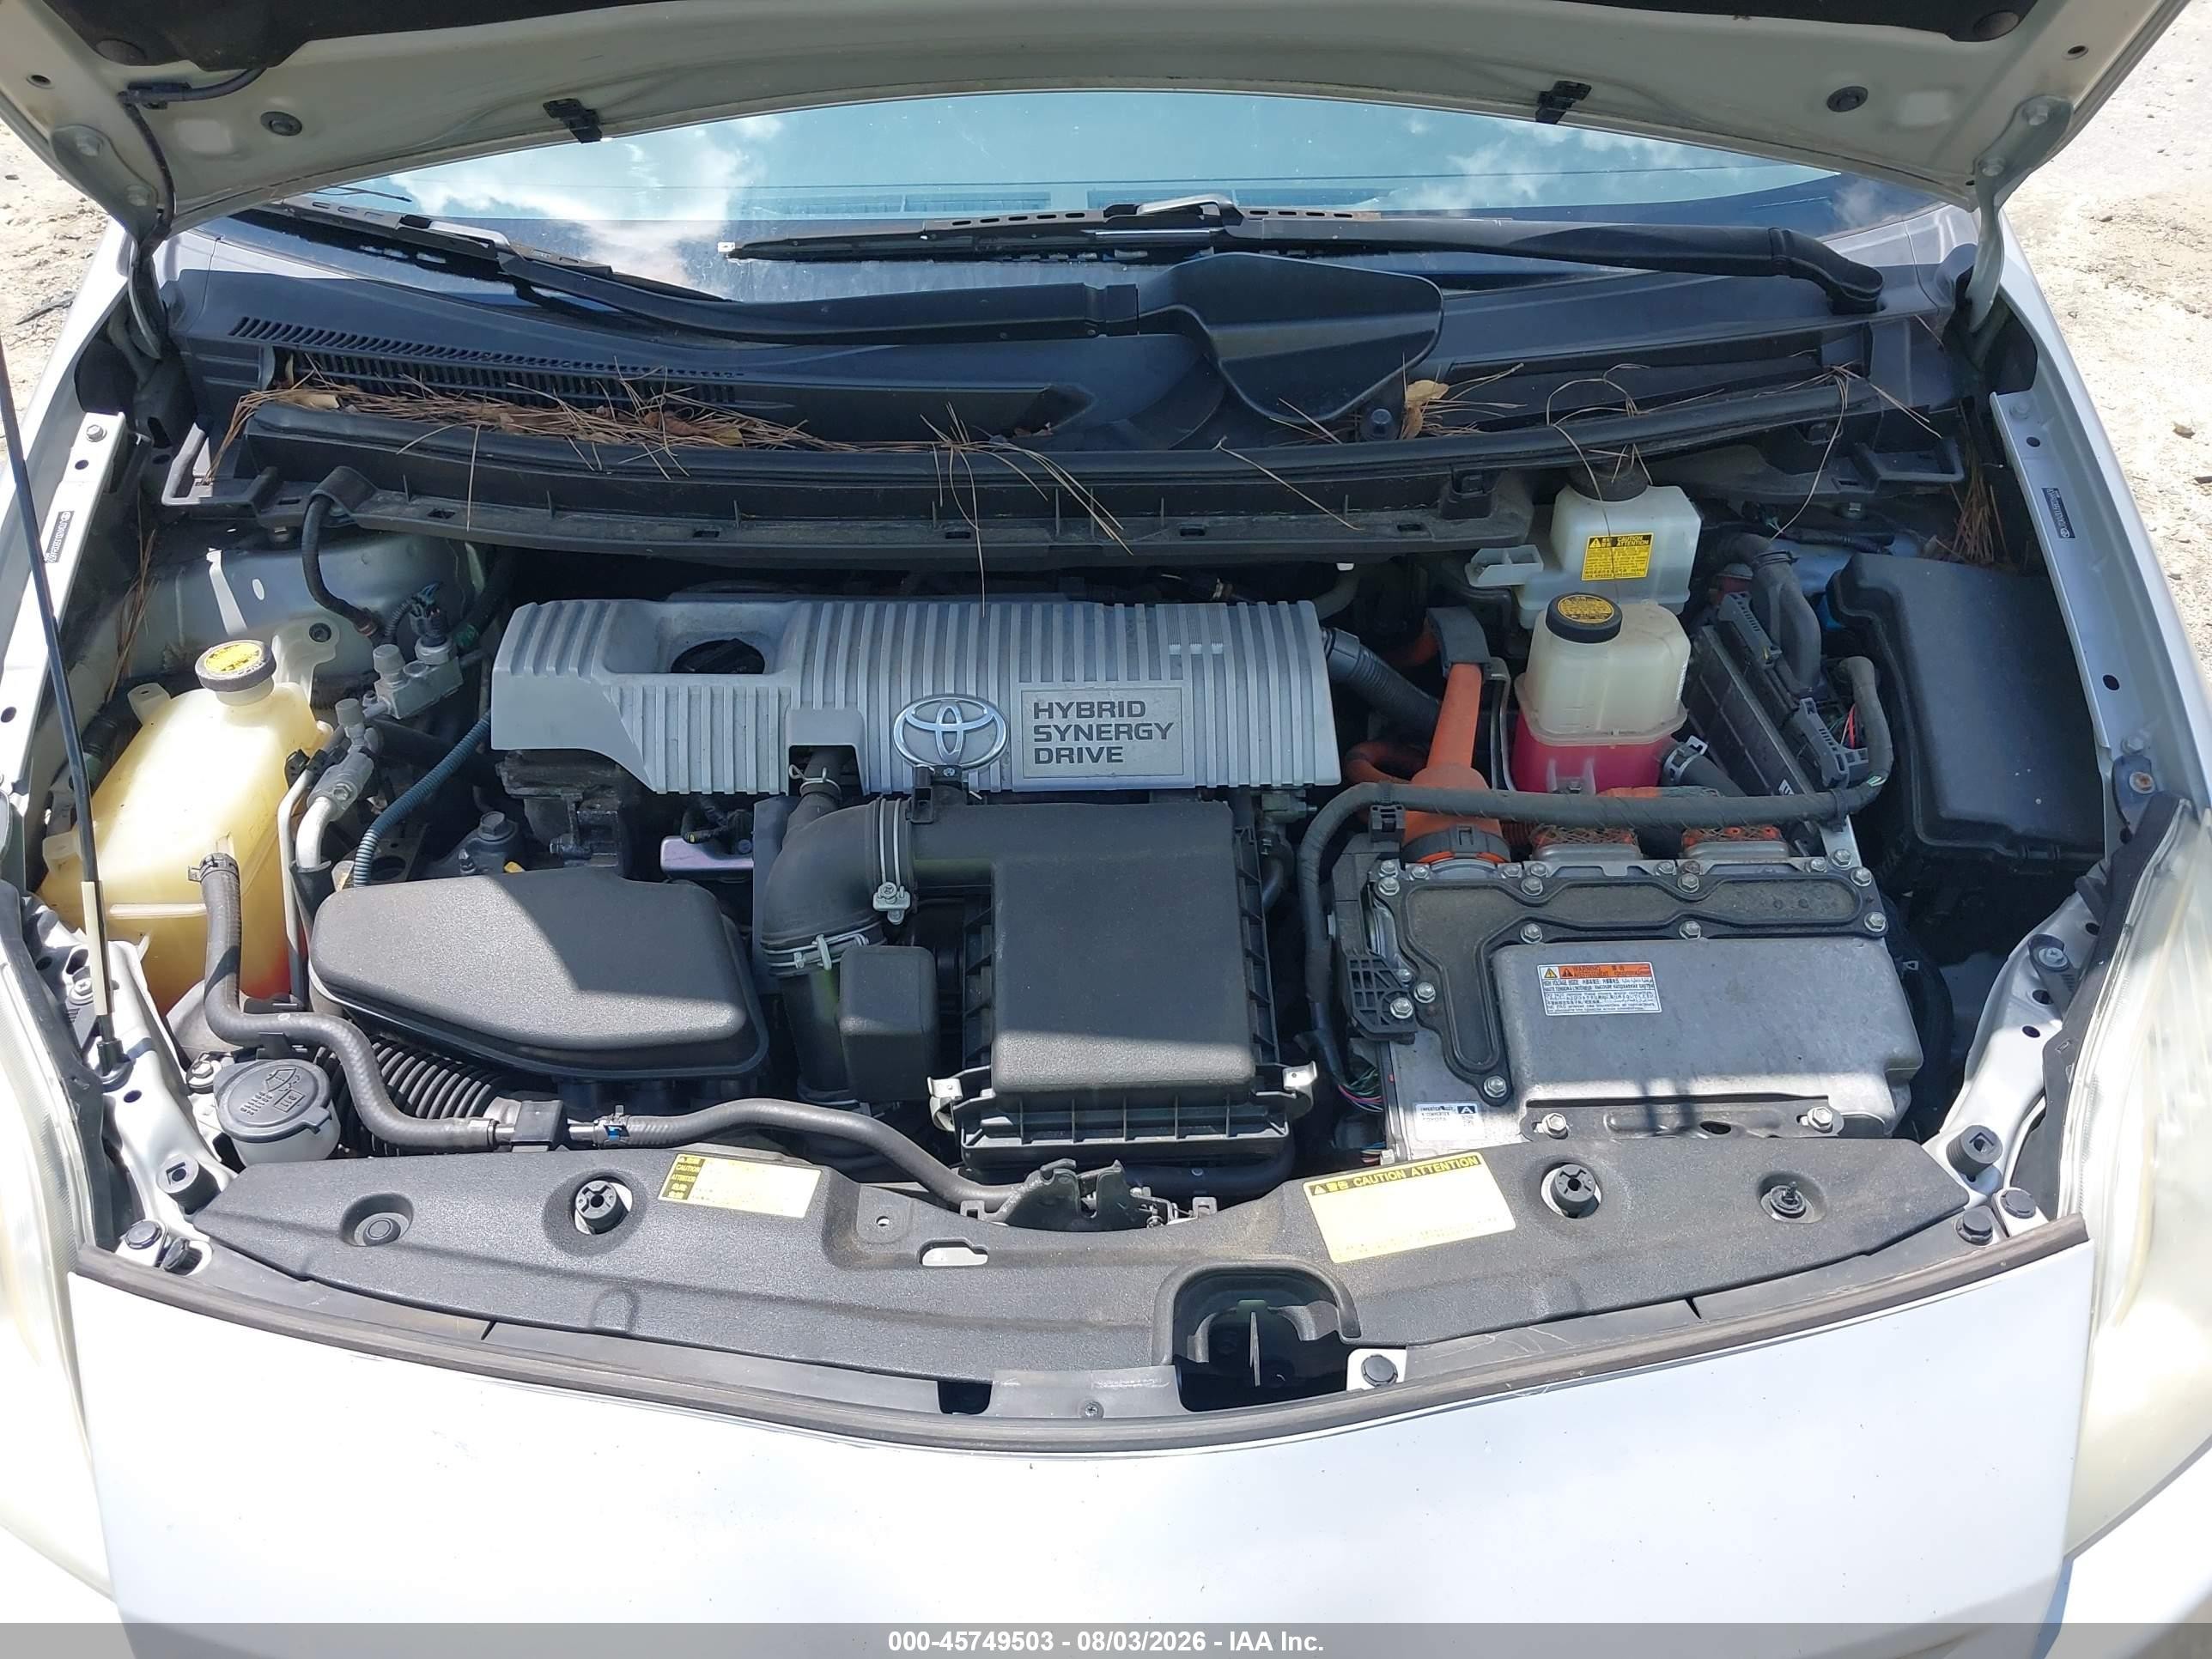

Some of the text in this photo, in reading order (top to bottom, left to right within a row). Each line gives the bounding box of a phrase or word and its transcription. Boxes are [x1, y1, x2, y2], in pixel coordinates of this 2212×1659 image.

[1033, 701, 1146, 719] HYBRID
[1034, 722, 1174, 742] SYNERGY
[1035, 746, 1124, 764] DRIVE
[676, 1164, 701, 1173] CAUTION
[1353, 1169, 1407, 1188] CAUTION
[1410, 1156, 1479, 1177] ATTENTION
